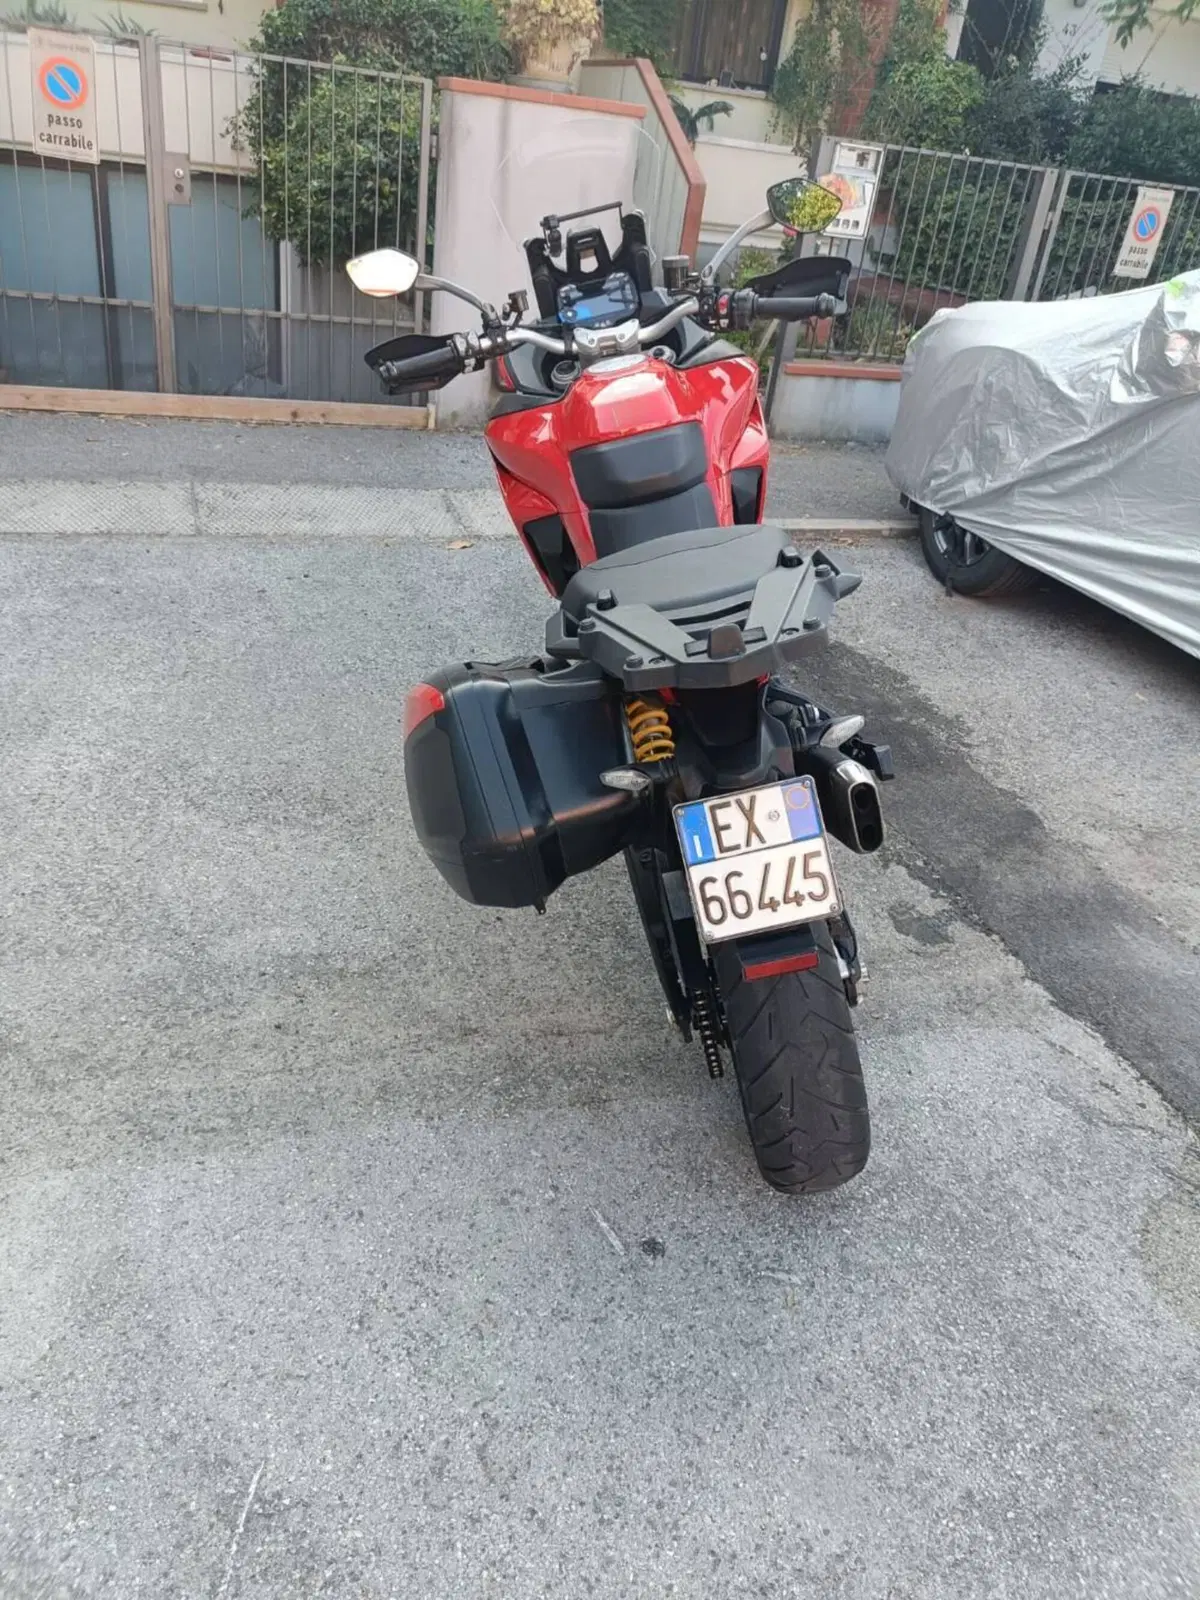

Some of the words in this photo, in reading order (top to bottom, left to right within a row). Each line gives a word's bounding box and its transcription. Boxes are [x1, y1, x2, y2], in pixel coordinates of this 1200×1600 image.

[47, 113, 83, 129] passo
[39, 132, 93, 151] carrabile
[709, 795, 766, 853] EX
[693, 835, 703, 858] I
[698, 850, 829, 925] 66445
